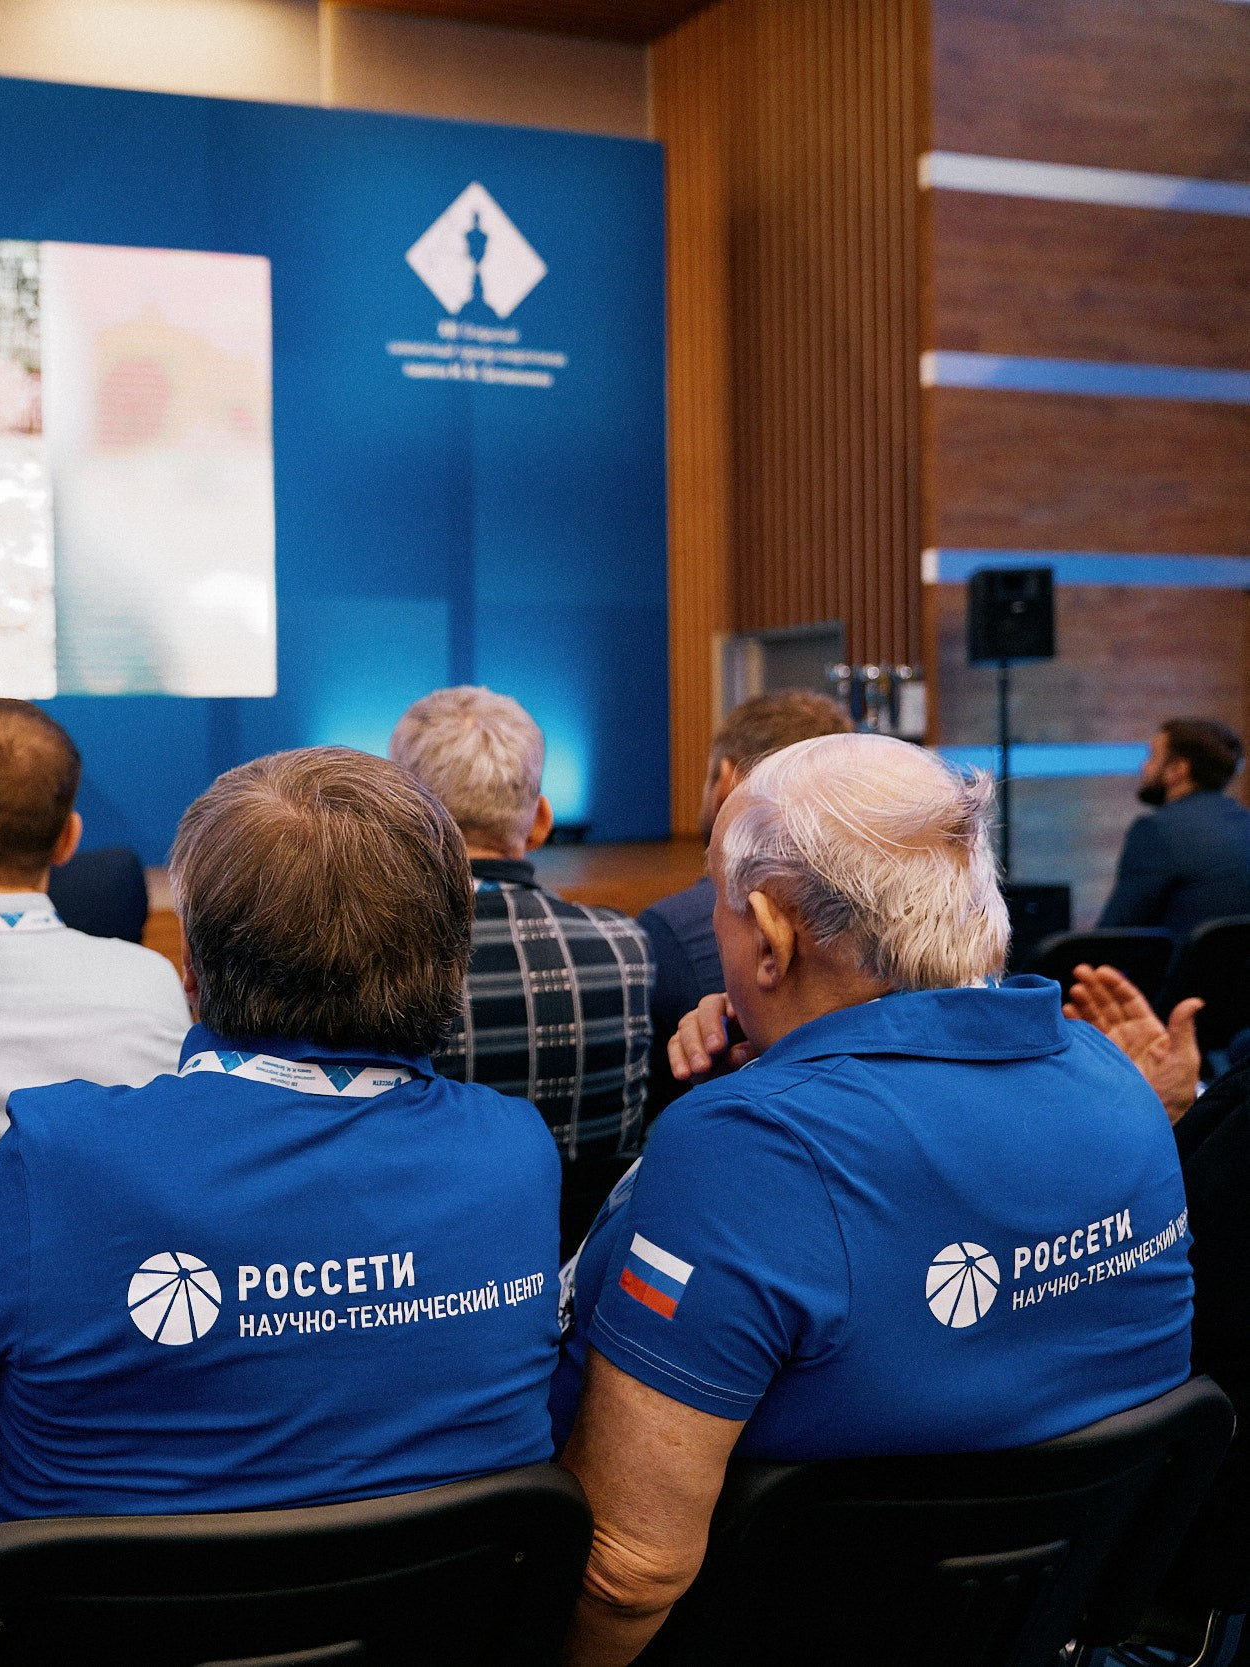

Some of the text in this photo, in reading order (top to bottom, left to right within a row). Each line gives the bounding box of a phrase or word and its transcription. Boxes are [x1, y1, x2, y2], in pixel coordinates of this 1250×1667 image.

[238, 1251, 415, 1301] РОССЕТИ
[1012, 1219, 1177, 1310] НАУЧНО-ТЕХНИЧЕСКИЙ
[1014, 1208, 1133, 1279] РОССЕТИ
[239, 1272, 544, 1338] НАУЧНО-ТЕХНИЧЕСКИЙ ЦЕНТР
